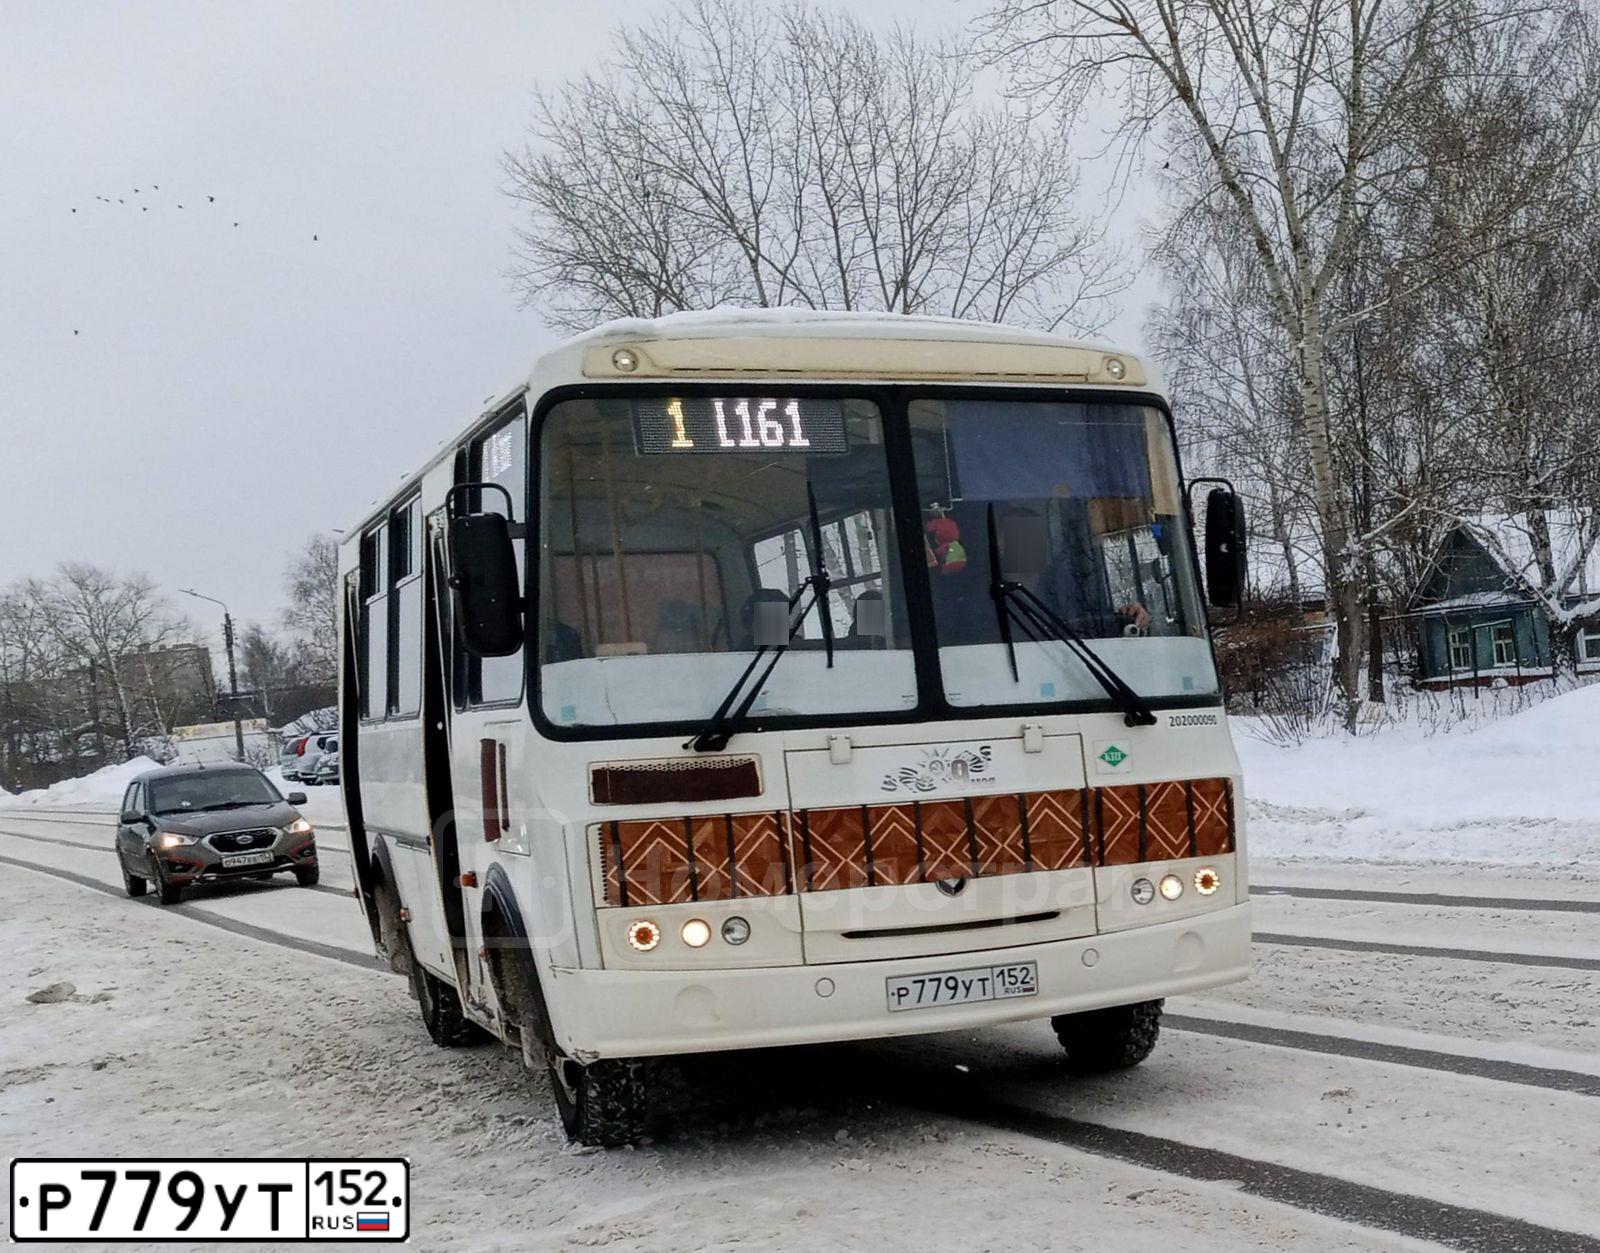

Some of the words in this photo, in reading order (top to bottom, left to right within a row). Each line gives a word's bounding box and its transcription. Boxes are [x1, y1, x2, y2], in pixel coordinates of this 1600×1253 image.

[667, 400, 694, 447] 1
[896, 976, 989, 1006] Р779УТ
[996, 966, 1030, 987] 152
